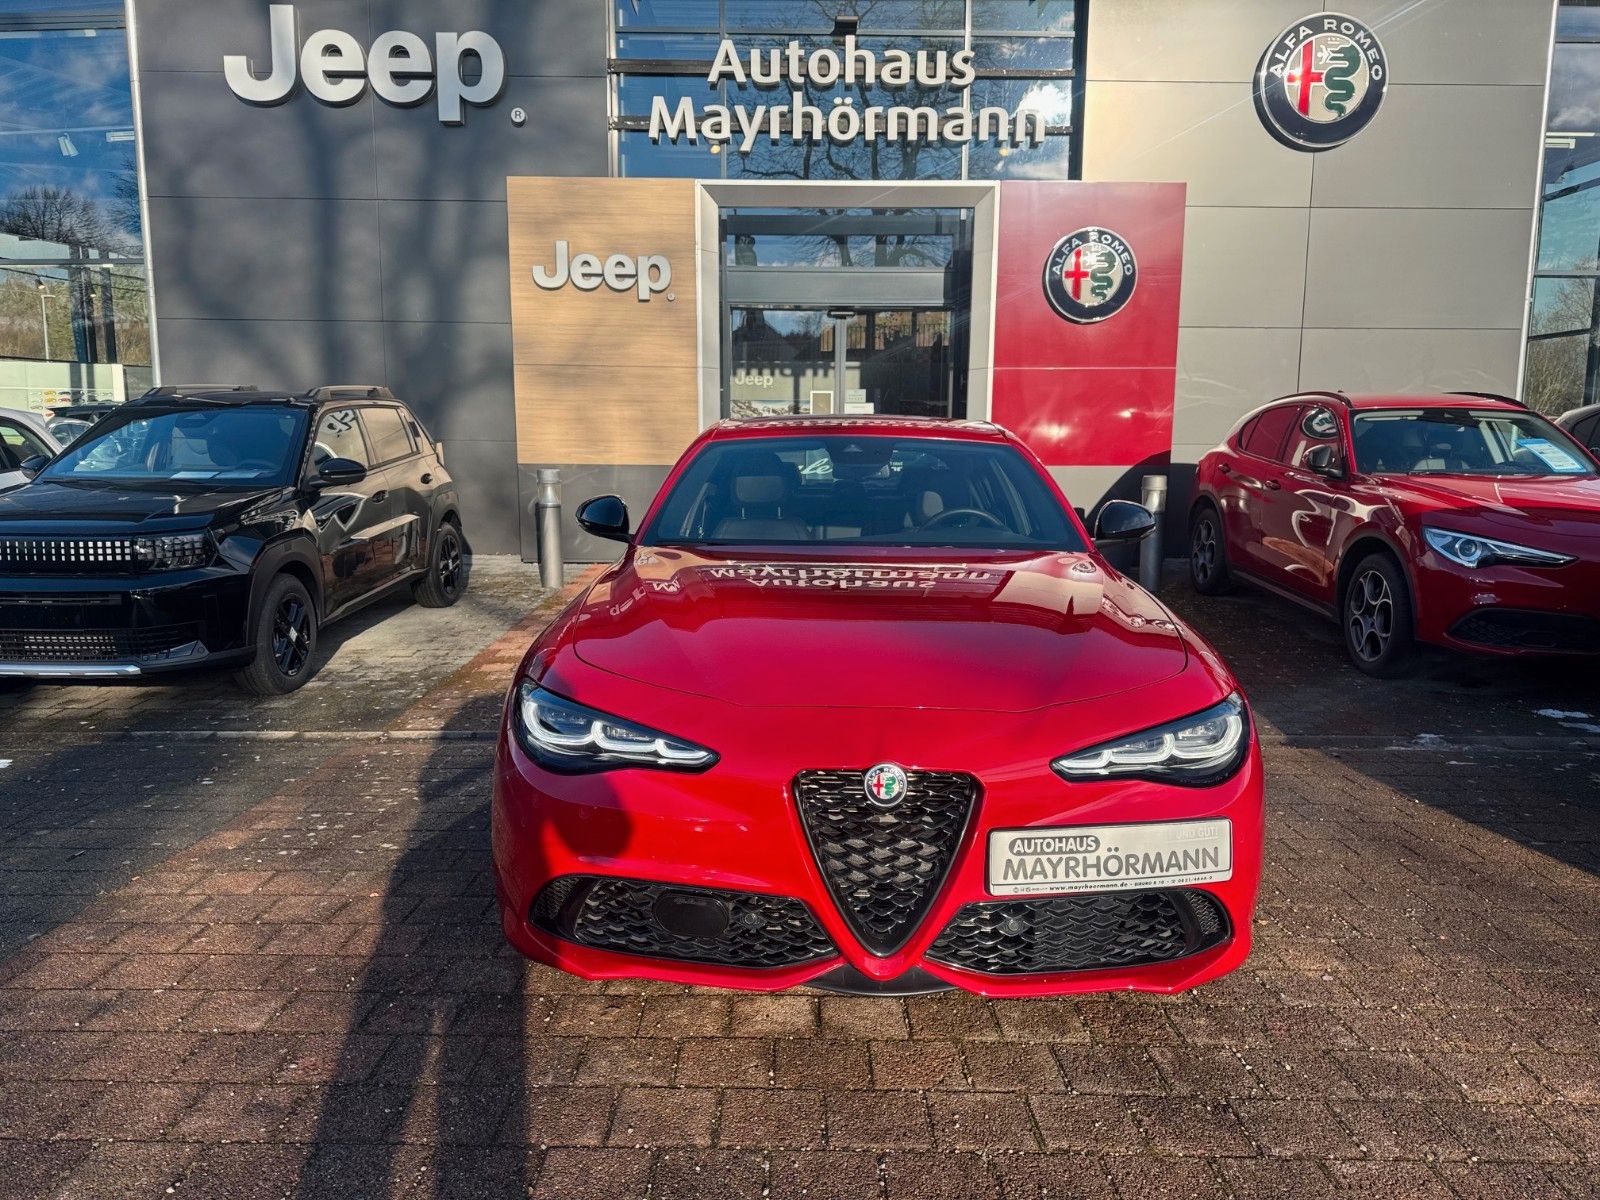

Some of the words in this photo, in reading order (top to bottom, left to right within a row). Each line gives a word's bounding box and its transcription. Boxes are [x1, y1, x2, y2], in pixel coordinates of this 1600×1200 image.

[223, 4, 505, 123] Jeep
[707, 35, 976, 88] Autohaus
[1269, 25, 1313, 78] ALFA
[1323, 19, 1382, 80] ROMEO
[648, 91, 1046, 153] Mayrhörmann
[532, 240, 672, 301] Jeep
[1052, 237, 1082, 275] ALFA
[1088, 231, 1133, 275] ROMEO
[734, 371, 774, 388] Jeep
[1002, 845, 1219, 880] MAYRHÖRMANN
[1013, 836, 1097, 854] AUTOHAUS
[1049, 881, 1128, 891] www.mayrhoermann.de
